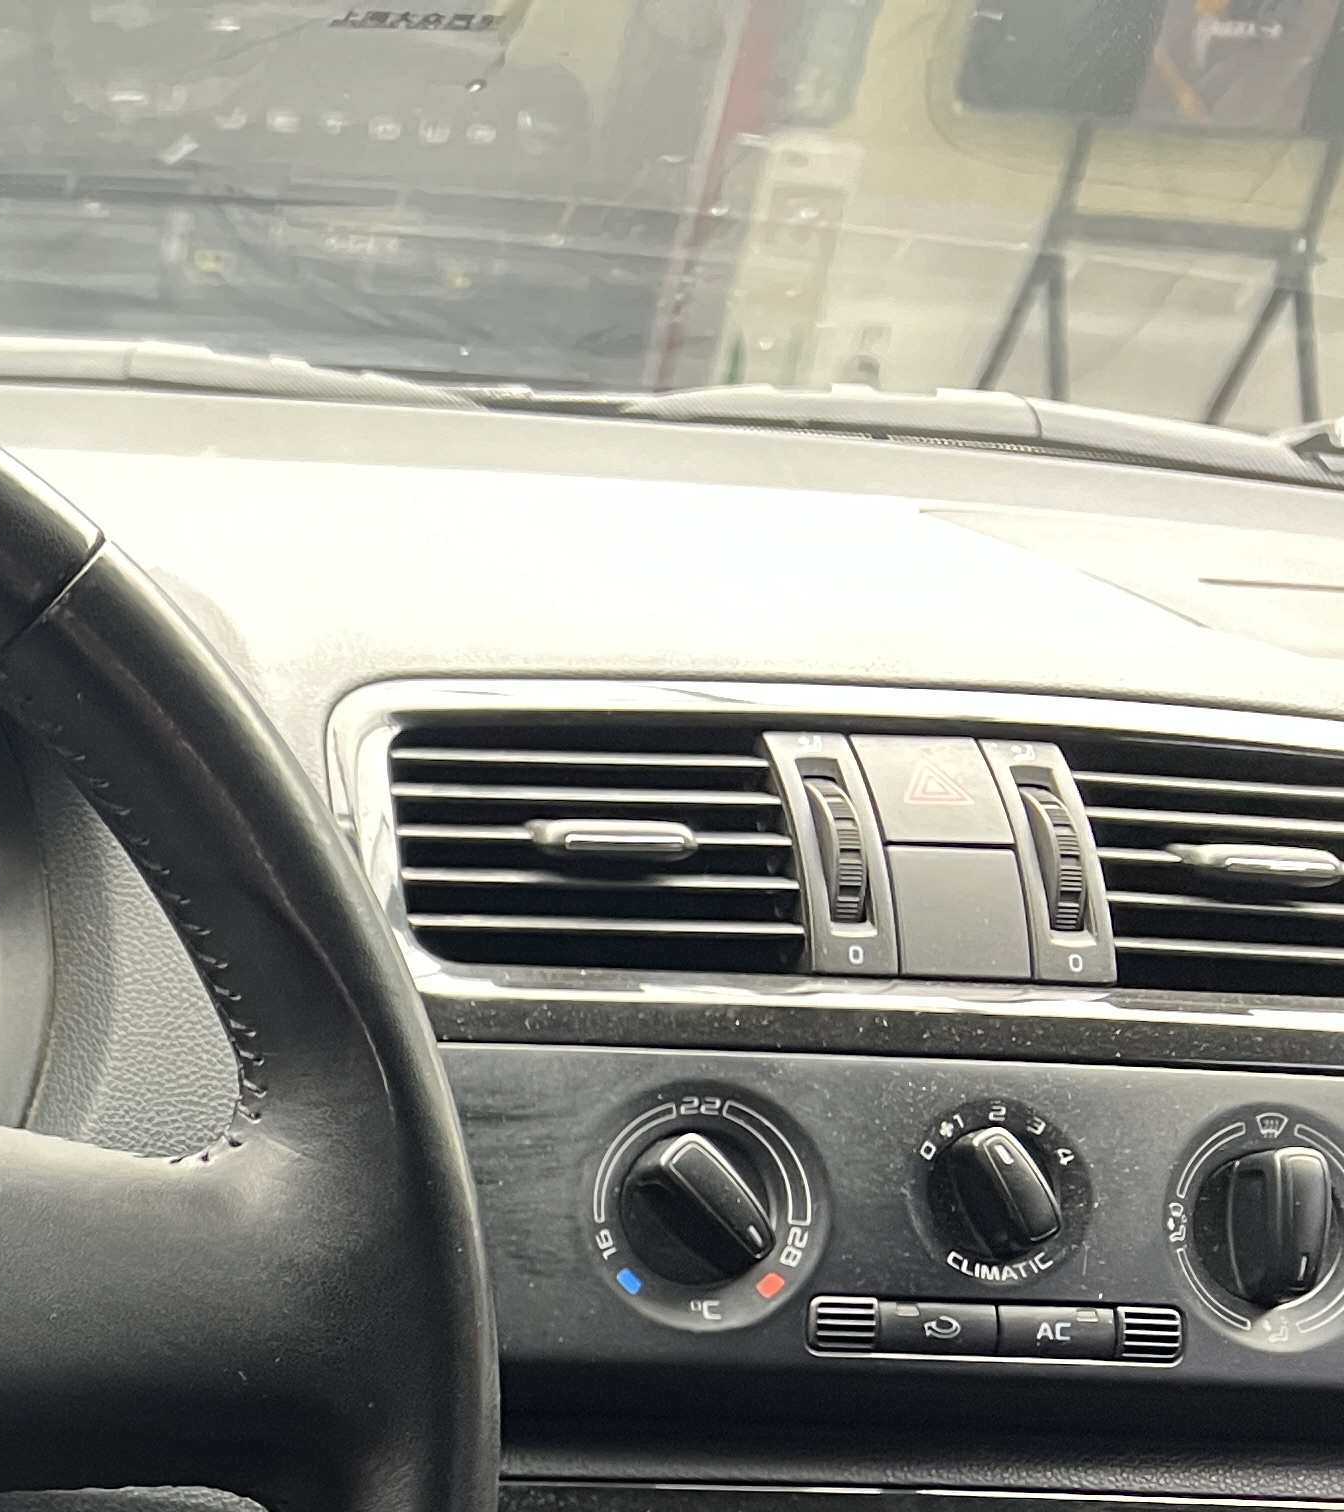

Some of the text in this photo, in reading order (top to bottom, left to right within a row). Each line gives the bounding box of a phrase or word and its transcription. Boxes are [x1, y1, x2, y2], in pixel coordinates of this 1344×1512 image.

[680, 1096, 722, 1116] 22
[989, 1105, 1006, 1121] 2
[952, 1113, 965, 1129] 1
[1026, 1117, 1047, 1136] 3
[919, 1141, 937, 1160] 0
[1056, 1147, 1075, 1166] 4
[594, 1229, 617, 1261] 16
[778, 1226, 810, 1268] 28
[946, 1250, 1054, 1282] CLIMATIC
[1035, 1321, 1072, 1342] AC
